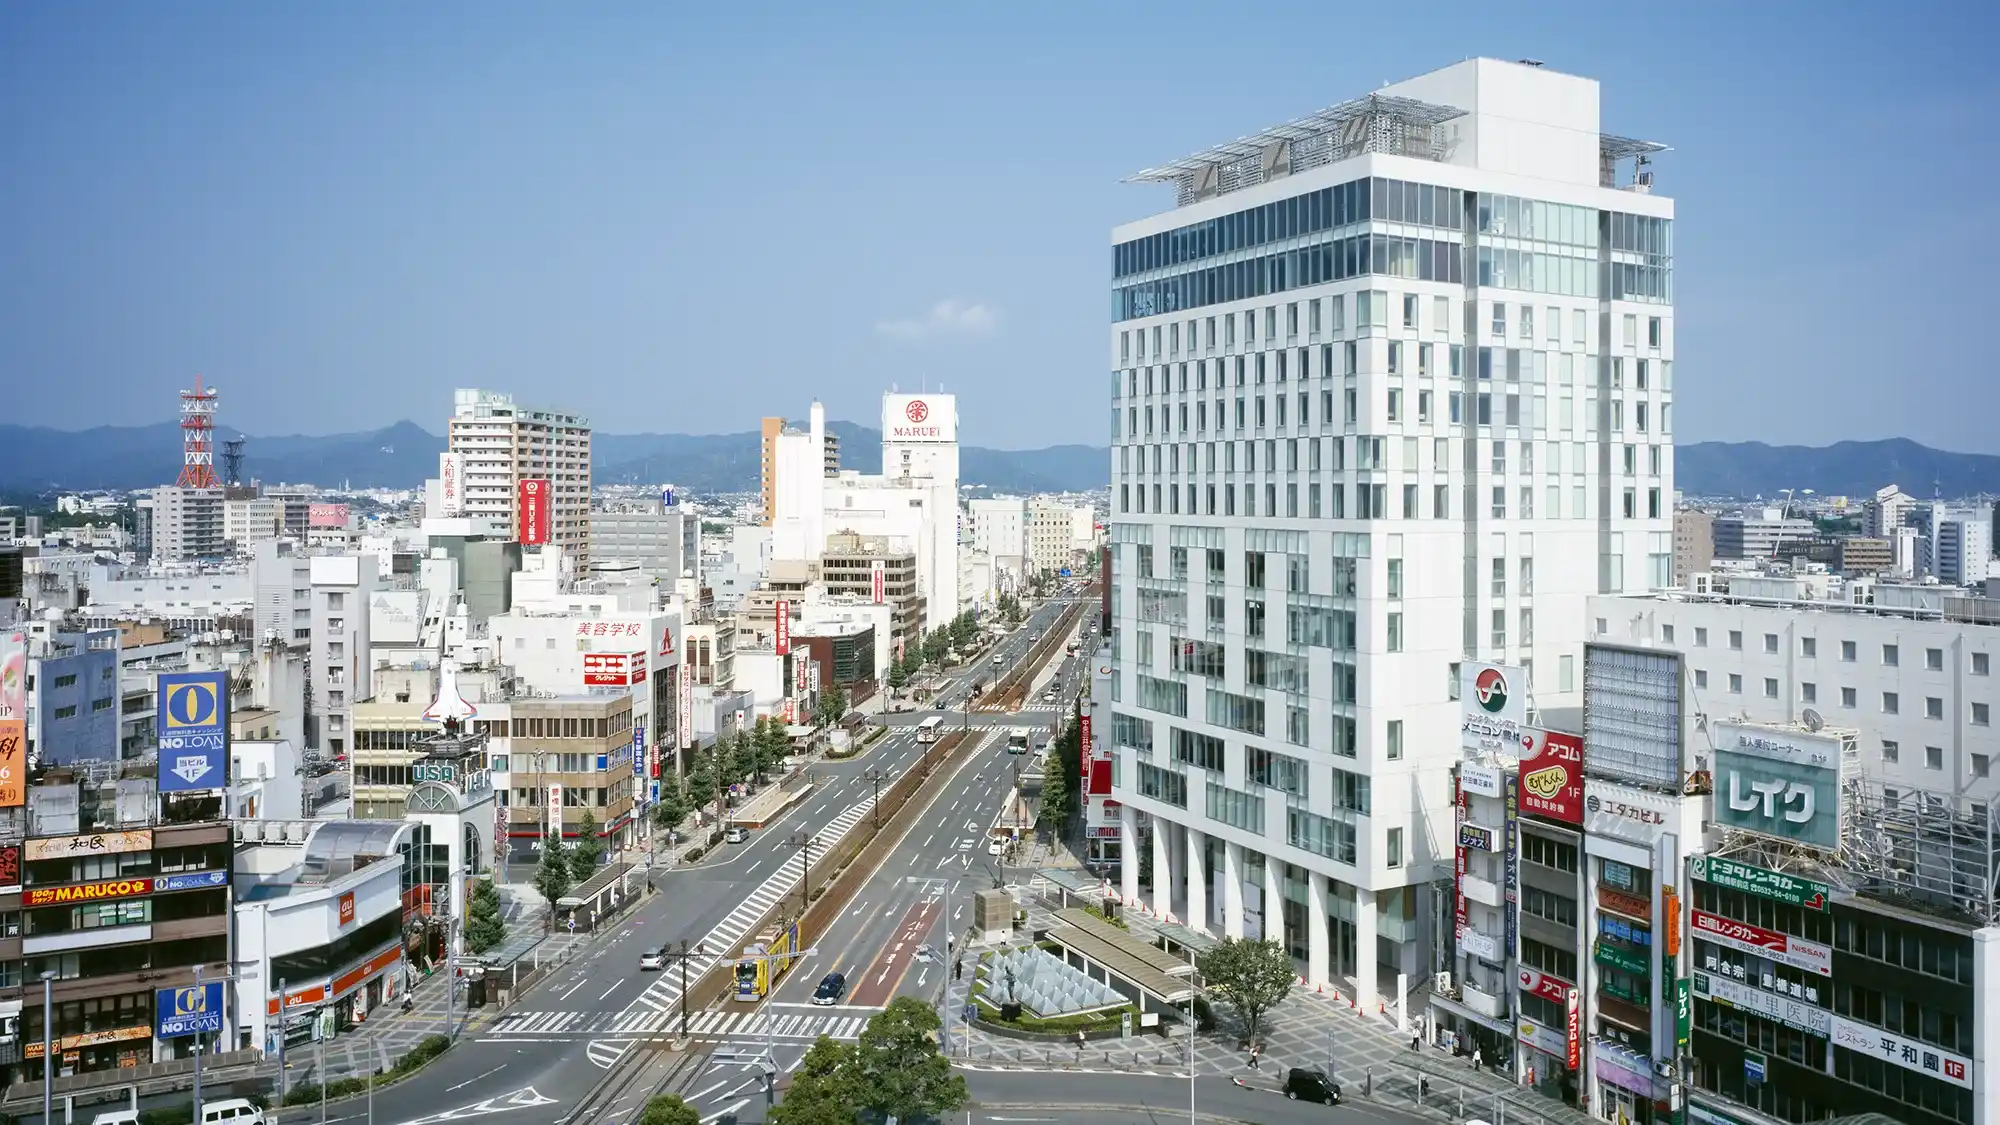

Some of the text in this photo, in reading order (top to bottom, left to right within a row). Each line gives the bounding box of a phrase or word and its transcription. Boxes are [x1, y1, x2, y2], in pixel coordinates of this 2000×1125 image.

[444, 457, 455, 499] 大和証券
[576, 622, 641, 637] 美容学校
[584, 656, 628, 673] ニコニコ
[1547, 742, 1581, 762] アコム
[180, 759, 205, 768] 当ビル
[184, 769, 199, 778] 1F
[412, 764, 455, 782] USA
[1527, 769, 1564, 788] むじんくん
[1567, 785, 1581, 799] 1F
[1729, 769, 1815, 823] レイク
[1526, 796, 1565, 814] 自動契約機
[1604, 800, 1664, 825] ユタカビル
[68, 835, 105, 850] 和民
[1711, 859, 1804, 891] トヨタレンタカー
[55, 882, 131, 901] MARUCO
[341, 899, 353, 913] au
[1698, 915, 1760, 940] 日産レンタカー
[1792, 943, 1826, 959] NISSAN
[363, 964, 372, 975] au
[1706, 955, 1745, 978] 阿含宗
[289, 996, 303, 1005] au
[1679, 987, 1688, 1019] レイク
[1744, 989, 1825, 1031] 中里医院
[1569, 1013, 1578, 1040] アコム
[1837, 1031, 1876, 1050] レストラン
[1947, 1062, 1962, 1077] 1F
